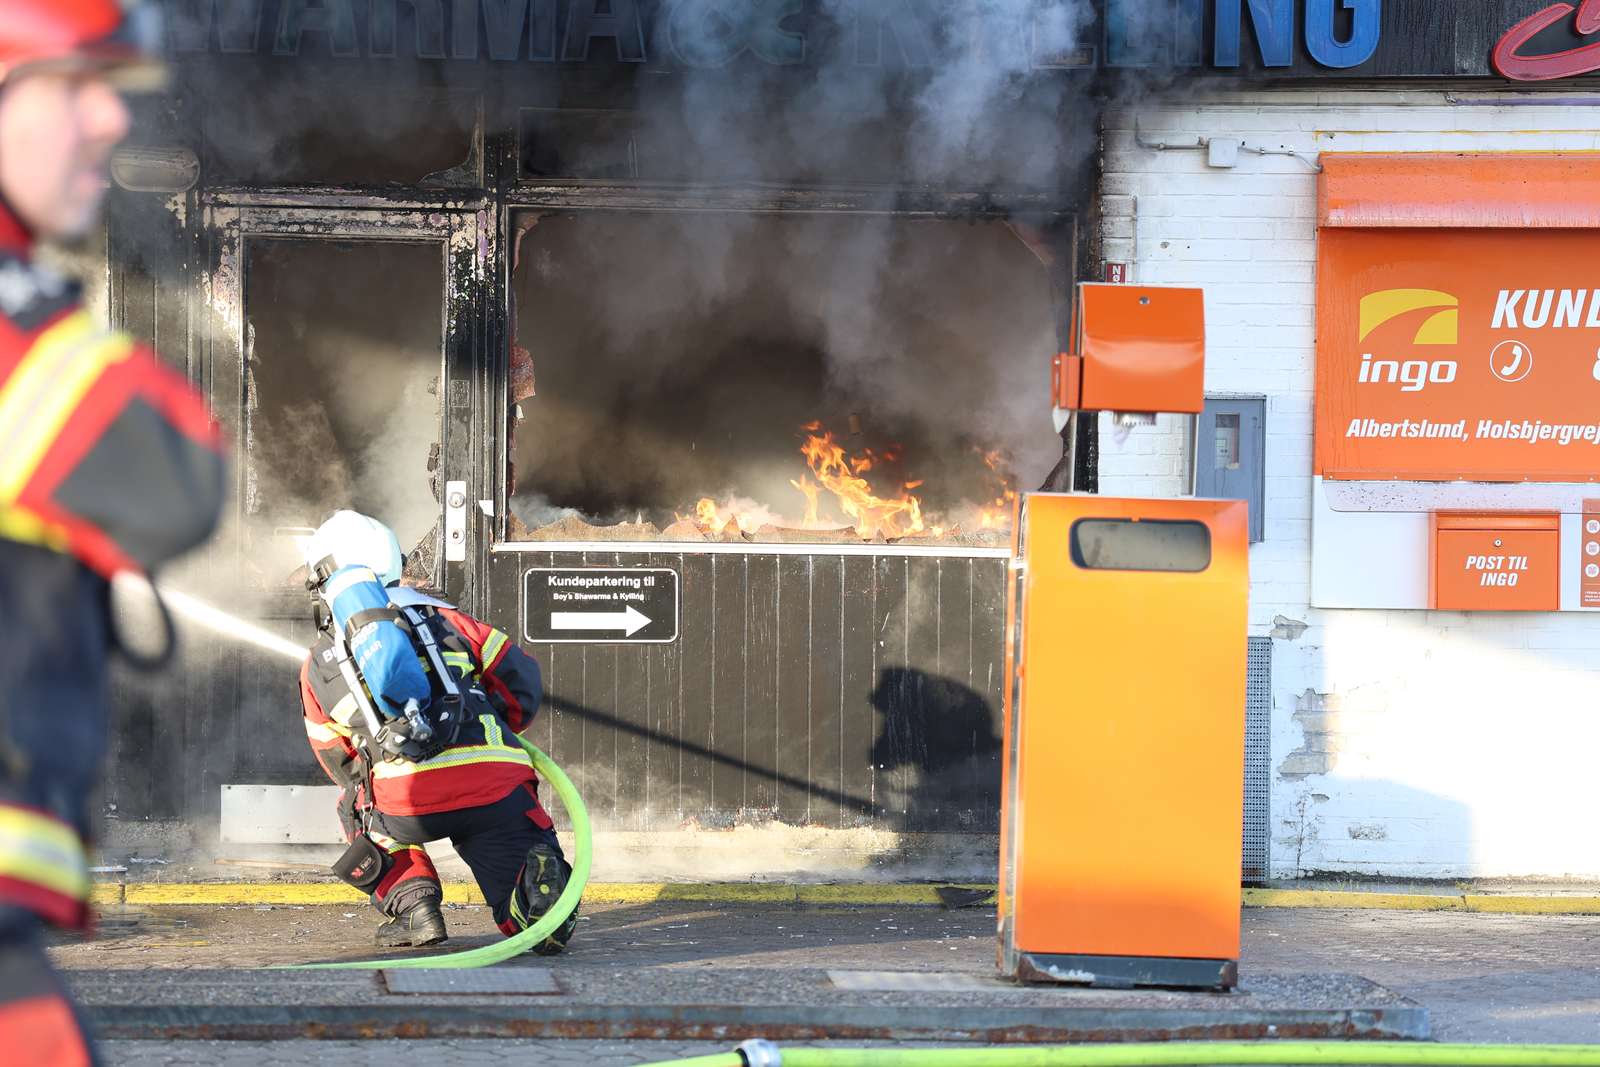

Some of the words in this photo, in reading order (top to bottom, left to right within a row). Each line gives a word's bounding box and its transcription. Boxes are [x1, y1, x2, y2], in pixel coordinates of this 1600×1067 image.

[1358, 353, 1458, 392] ingo
[1346, 418, 1469, 441] Albertslund,
[1465, 555, 1505, 570] POST
[1508, 555, 1528, 570] TIL
[548, 575, 641, 589] Kundeparkering
[643, 576, 655, 587] til
[1480, 572, 1518, 586] INGO
[553, 592, 573, 602] Boy's
[619, 592, 645, 601] Kylling
